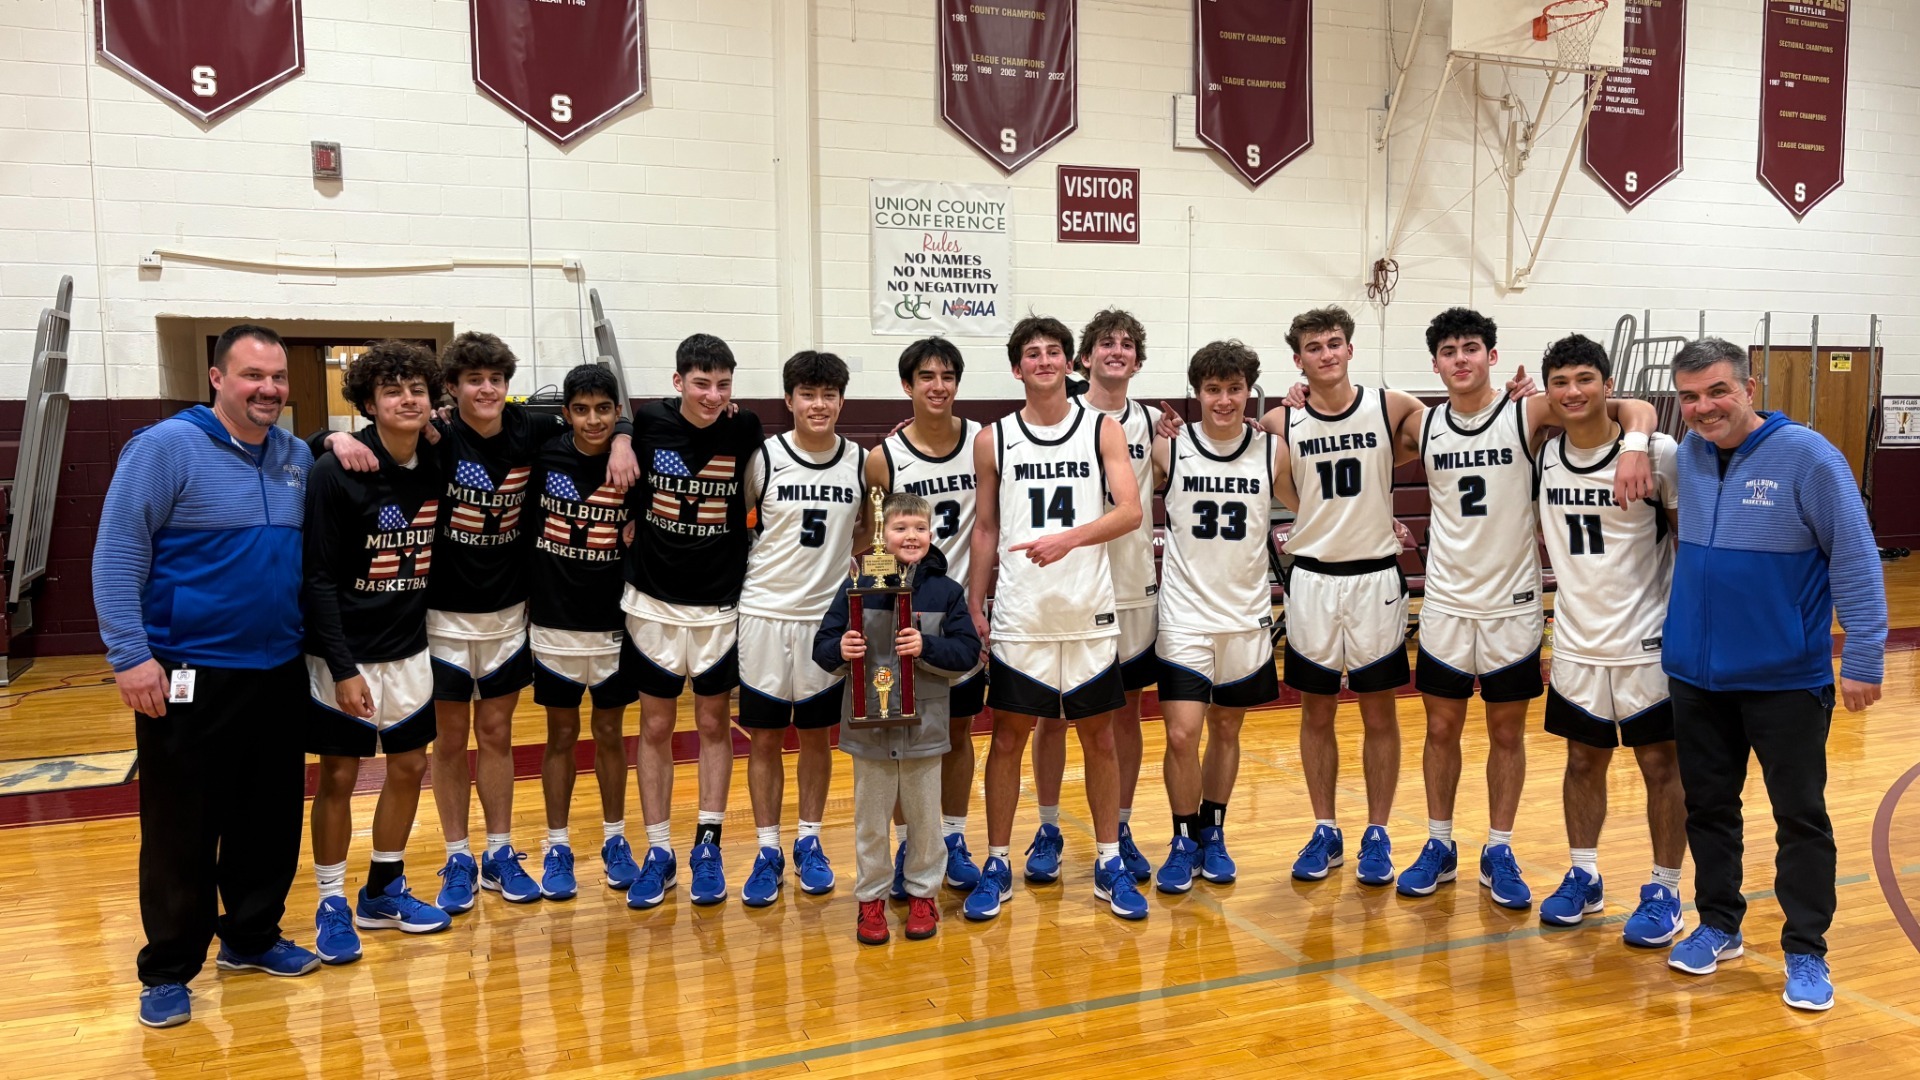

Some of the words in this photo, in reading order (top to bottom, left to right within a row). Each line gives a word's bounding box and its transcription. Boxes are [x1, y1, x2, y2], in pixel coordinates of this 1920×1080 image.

[952, 13, 967, 22] 1981
[970, 5, 999, 16] COUNTY
[1002, 8, 1046, 20] CHAMPIONS
[1789, 4, 1826, 16] WRESTLING
[1786, 17, 1799, 25] STATE
[1801, 19, 1828, 29] CHAMPIONS
[1219, 30, 1245, 40] COUNTY
[1247, 34, 1286, 45] CHAMPIONS
[1779, 40, 1804, 50] SECTIONAL
[1805, 43, 1833, 54] CHAMPIONS
[971, 53, 999, 64] LEAGUE
[1002, 57, 1045, 69] CHAMPIONS
[190, 65, 218, 97] S
[952, 64, 968, 72] 1997
[1000, 68, 1016, 77] 2002
[1025, 70, 1039, 79] 2011
[1048, 72, 1065, 80] 2022
[952, 74, 968, 82] 2023
[1780, 71, 1801, 81] DISTRICT
[1803, 74, 1830, 84] CHAMPIONS
[1222, 76, 1244, 86] LEAGUE
[1247, 79, 1286, 89] CHAMPIONS
[551, 94, 573, 123] S
[1780, 110, 1798, 119] COUNTY
[1799, 112, 1827, 121] CHAMPIONS
[1000, 128, 1017, 153] S
[1778, 141, 1797, 149] LEAGUE
[1798, 143, 1825, 152] CHAMPIONS
[1246, 144, 1261, 167] S
[1064, 176, 1134, 199] VISITOR
[1625, 171, 1638, 192] S
[1794, 182, 1806, 202] S
[875, 197, 931, 212] UNION
[937, 200, 1005, 215] COUNTY
[875, 212, 1005, 230] CONFERENCE
[1062, 210, 1136, 233] SEATING
[923, 231, 962, 253] Rules
[904, 252, 926, 264] NO
[931, 253, 982, 266] NAMES
[893, 266, 915, 277] NO
[920, 267, 991, 280] NUMBERS
[887, 281, 908, 292] NO
[914, 281, 998, 294] NEGATIVITY
[1297, 432, 1377, 457] MILLERS
[1432, 447, 1513, 470] MILLERS
[1013, 461, 1090, 481] MILLERS
[1315, 457, 1362, 500] 10
[648, 471, 738, 496] MILLBURN
[1182, 475, 1260, 495] MILLERS
[777, 484, 854, 504] MILLERS
[1457, 474, 1487, 517] 2
[540, 494, 629, 522] MILLBURN
[1028, 486, 1076, 528] 14
[645, 509, 731, 537] BASKETBALL
[799, 509, 828, 549] 5
[934, 499, 961, 539] 3
[1191, 500, 1248, 540] 33
[1564, 513, 1605, 555] 11
[536, 536, 621, 562] BASKETBALL
[354, 576, 428, 592] BASKETBA
